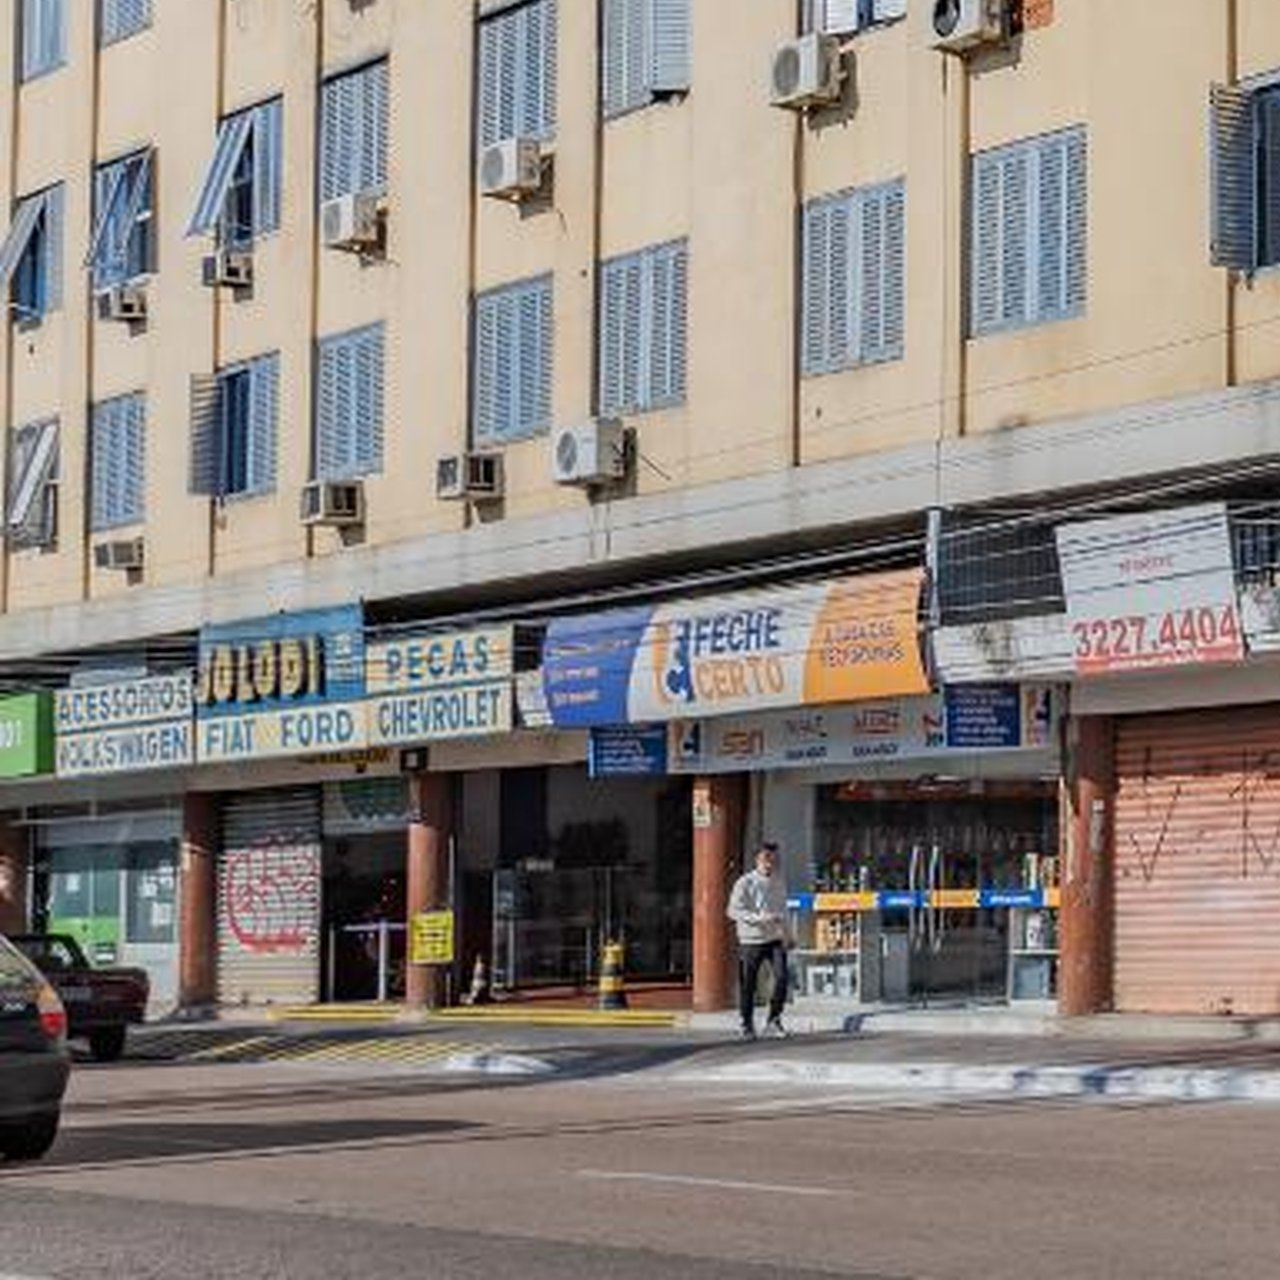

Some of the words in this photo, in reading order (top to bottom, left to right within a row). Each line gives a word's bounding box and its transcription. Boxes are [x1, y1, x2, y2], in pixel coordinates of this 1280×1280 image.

[693, 609, 784, 656] FECHE
[1072, 604, 1238, 658] 3227.4404
[694, 655, 785, 698] CERTO
[58, 677, 188, 724] ACESSORIOS
[378, 687, 501, 737] CHEVROLET
[205, 720, 256, 755] FIAT
[280, 710, 353, 747] FORD
